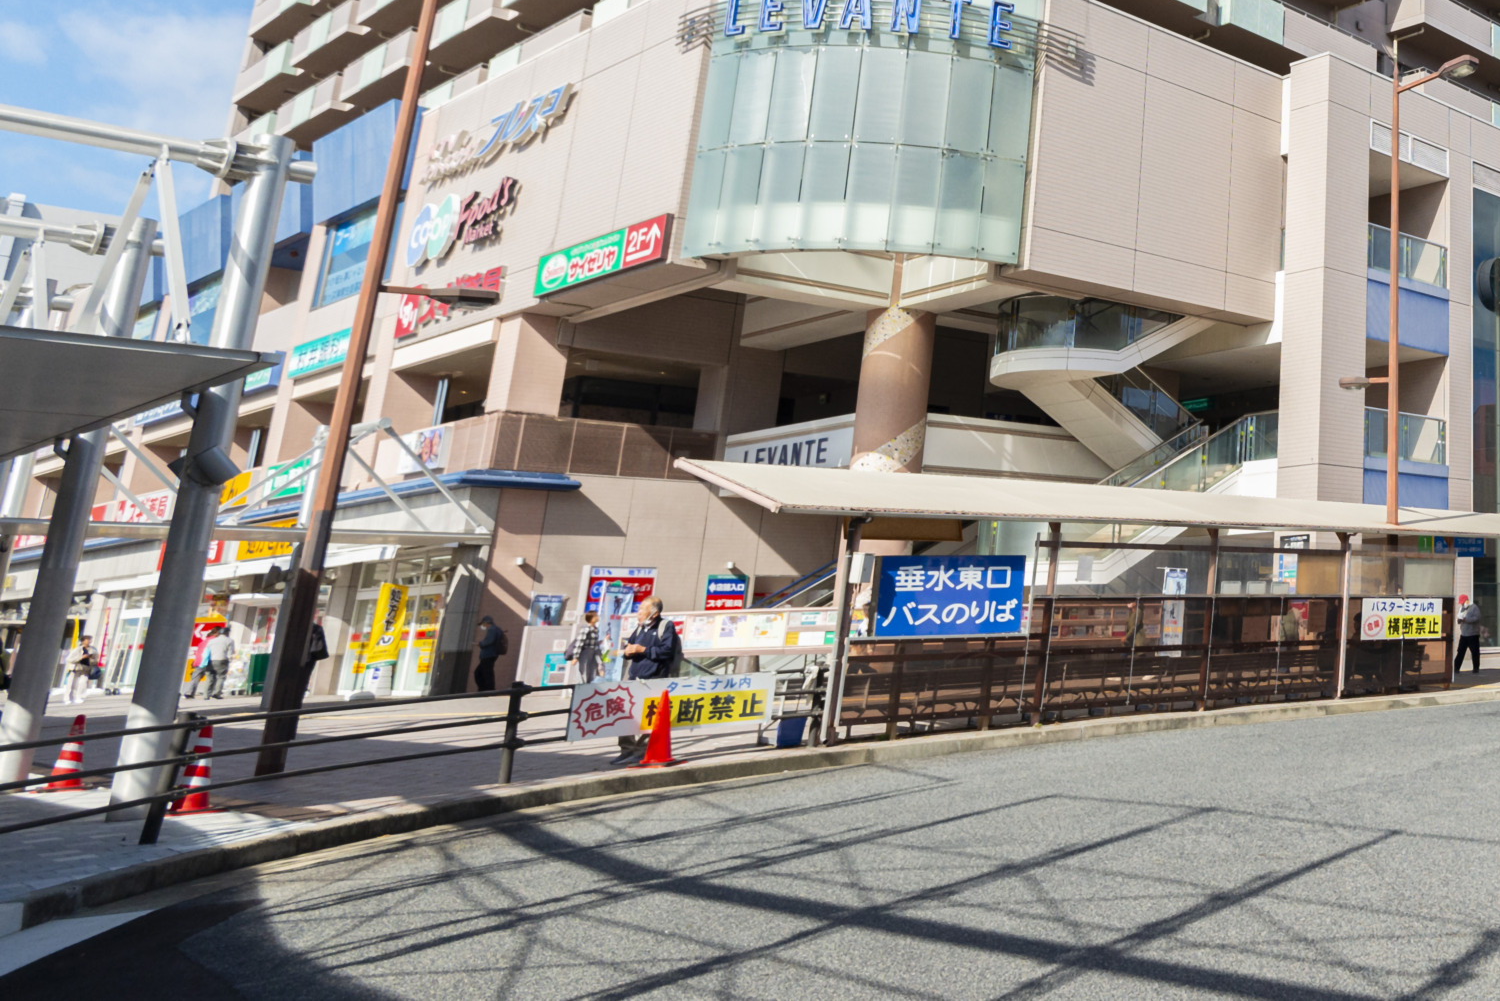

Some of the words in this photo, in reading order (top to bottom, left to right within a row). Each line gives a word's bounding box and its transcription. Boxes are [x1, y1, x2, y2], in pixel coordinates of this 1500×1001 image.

[454, 177, 513, 240] Food's
[464, 222, 494, 244] Market
[568, 246, 618, 282] サイゼリヤ
[627, 227, 648, 253] 2F
[895, 565, 1012, 592] 垂水東口
[706, 599, 742, 608] スギ薬局
[882, 598, 1018, 627] バスのりば
[1371, 601, 1434, 612] バスターミナル内
[1388, 617, 1439, 635] 横断禁止
[667, 676, 751, 693] ターミナル内
[585, 696, 626, 723] 危険
